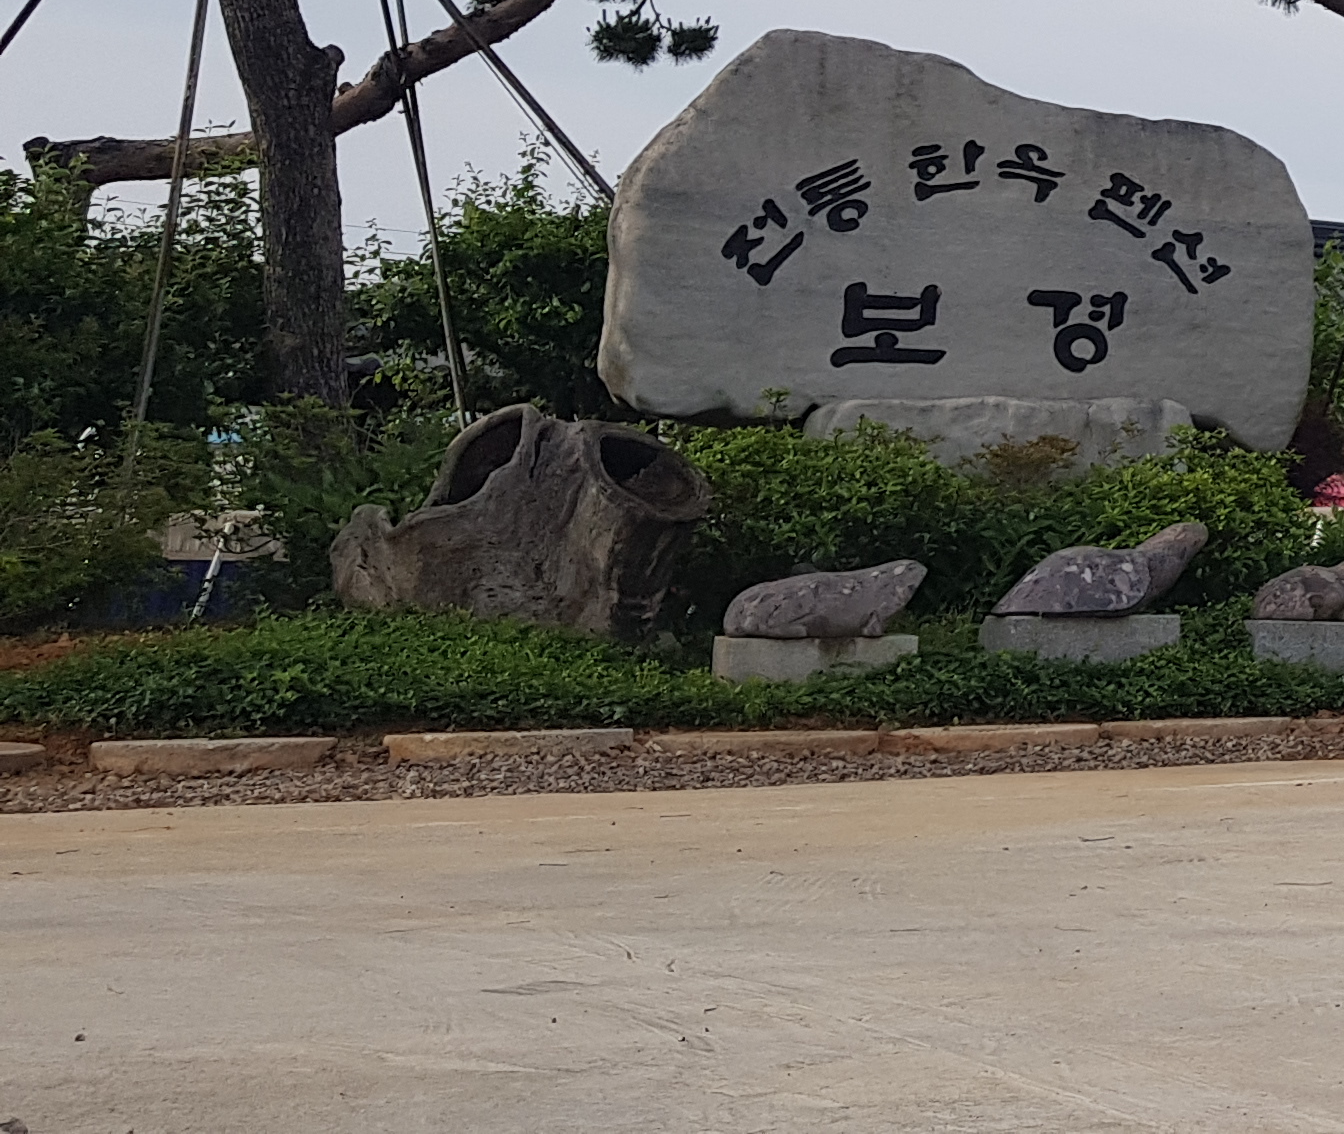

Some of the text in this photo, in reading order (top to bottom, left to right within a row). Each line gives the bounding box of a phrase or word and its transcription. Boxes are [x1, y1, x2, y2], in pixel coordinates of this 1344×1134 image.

[720, 139, 1232, 295] 전통 한옥 펜션
[829, 281, 1129, 374] 보경
